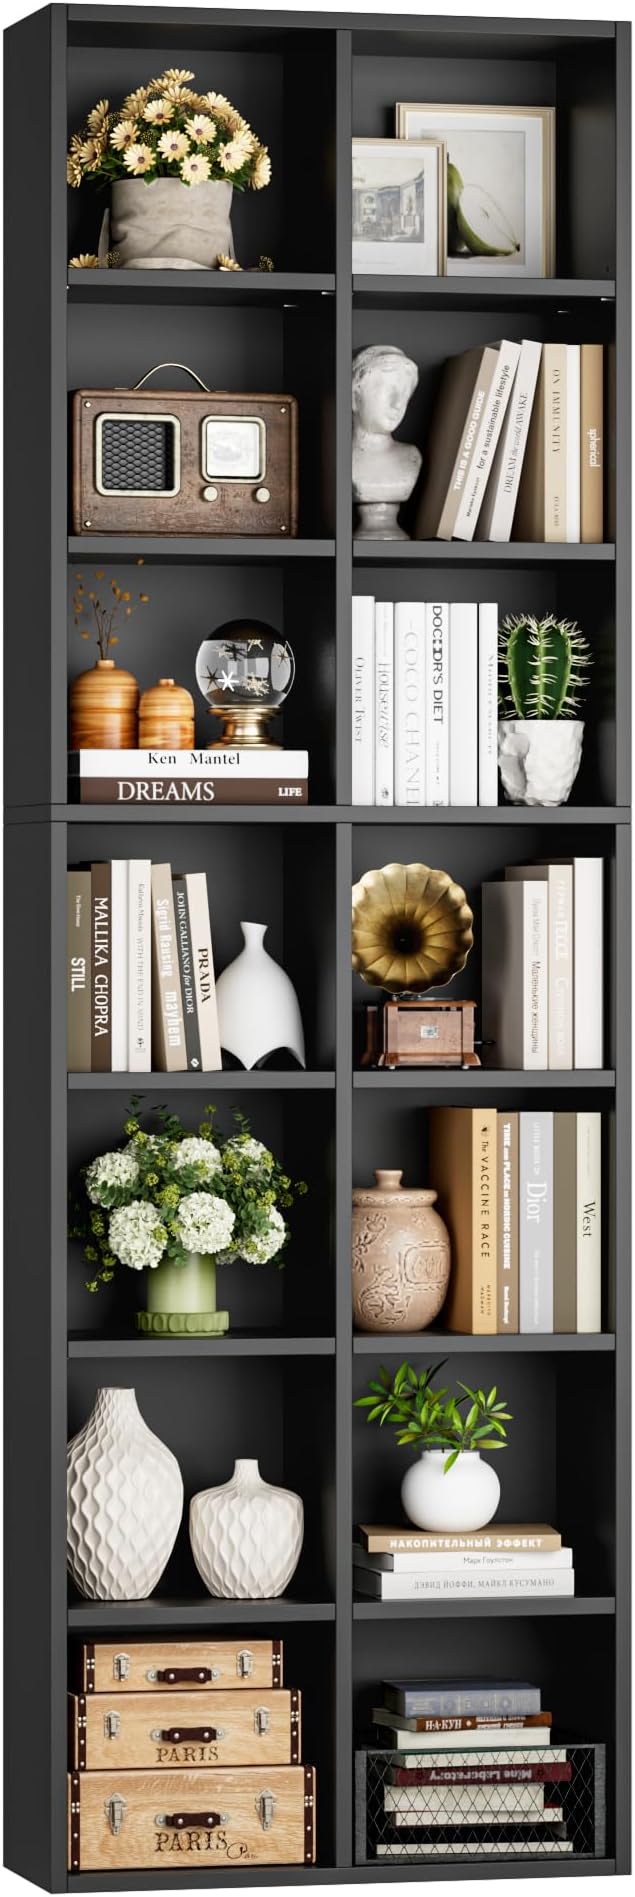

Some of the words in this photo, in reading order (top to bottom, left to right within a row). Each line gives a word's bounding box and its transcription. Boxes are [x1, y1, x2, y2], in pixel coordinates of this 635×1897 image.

[552, 368, 561, 384] ON
[469, 390, 486, 420] GUIDE
[476, 456, 487, 470] for
[484, 399, 500, 448] sustainable
[495, 364, 510, 398] lifestyle
[552, 391, 561, 453] IMMUNITY
[463, 421, 478, 450] GOOD
[504, 457, 517, 494] DREAM
[515, 391, 529, 427] AWAKE
[587, 428, 601, 468] spherical
[459, 460, 468, 469] IS
[461, 451, 470, 459] A
[453, 469, 466, 491] THIS
[404, 631, 419, 703] COCO
[433, 689, 444, 725] DIET
[148, 752, 177, 765] Ken
[189, 752, 241, 765] Mantel
[117, 781, 215, 801] DREAMS
[278, 787, 303, 797] LIFE
[156, 898, 171, 932] Sigrid
[176, 890, 186, 919] JOHN
[94, 897, 109, 967] MALLIKA
[177, 920, 191, 973] GALLIANO
[158, 934, 173, 978] Rausing
[71, 957, 86, 992] STILL
[182, 972, 192, 987] for
[197, 947, 211, 1004] PRADA
[94, 974, 109, 1037] CHOPRA
[184, 987, 195, 1014] DIOR
[164, 991, 182, 1047] mayhem
[481, 1140, 490, 1153] The
[502, 1122, 512, 1147] TIME
[480, 1156, 490, 1216] VACCINE
[502, 1161, 512, 1190] PLACE
[502, 1197, 512, 1232] NORDIC
[526, 1181, 549, 1224] Dior
[582, 1200, 596, 1238] West
[480, 1223, 491, 1258] RACE
[502, 1232, 512, 1270] CUISINE
[389, 1537, 492, 1549] НАКОПИТЕЛЬНЫЙ
[496, 1537, 545, 1548] ЭФФЕКТ
[414, 1580, 441, 1590] ДЭВИД
[509, 1577, 555, 1588] КУСУМАНО
[155, 1746, 219, 1763] PARIS
[504, 1768, 532, 1779] Mine
[154, 1830, 228, 1853] PARIS
